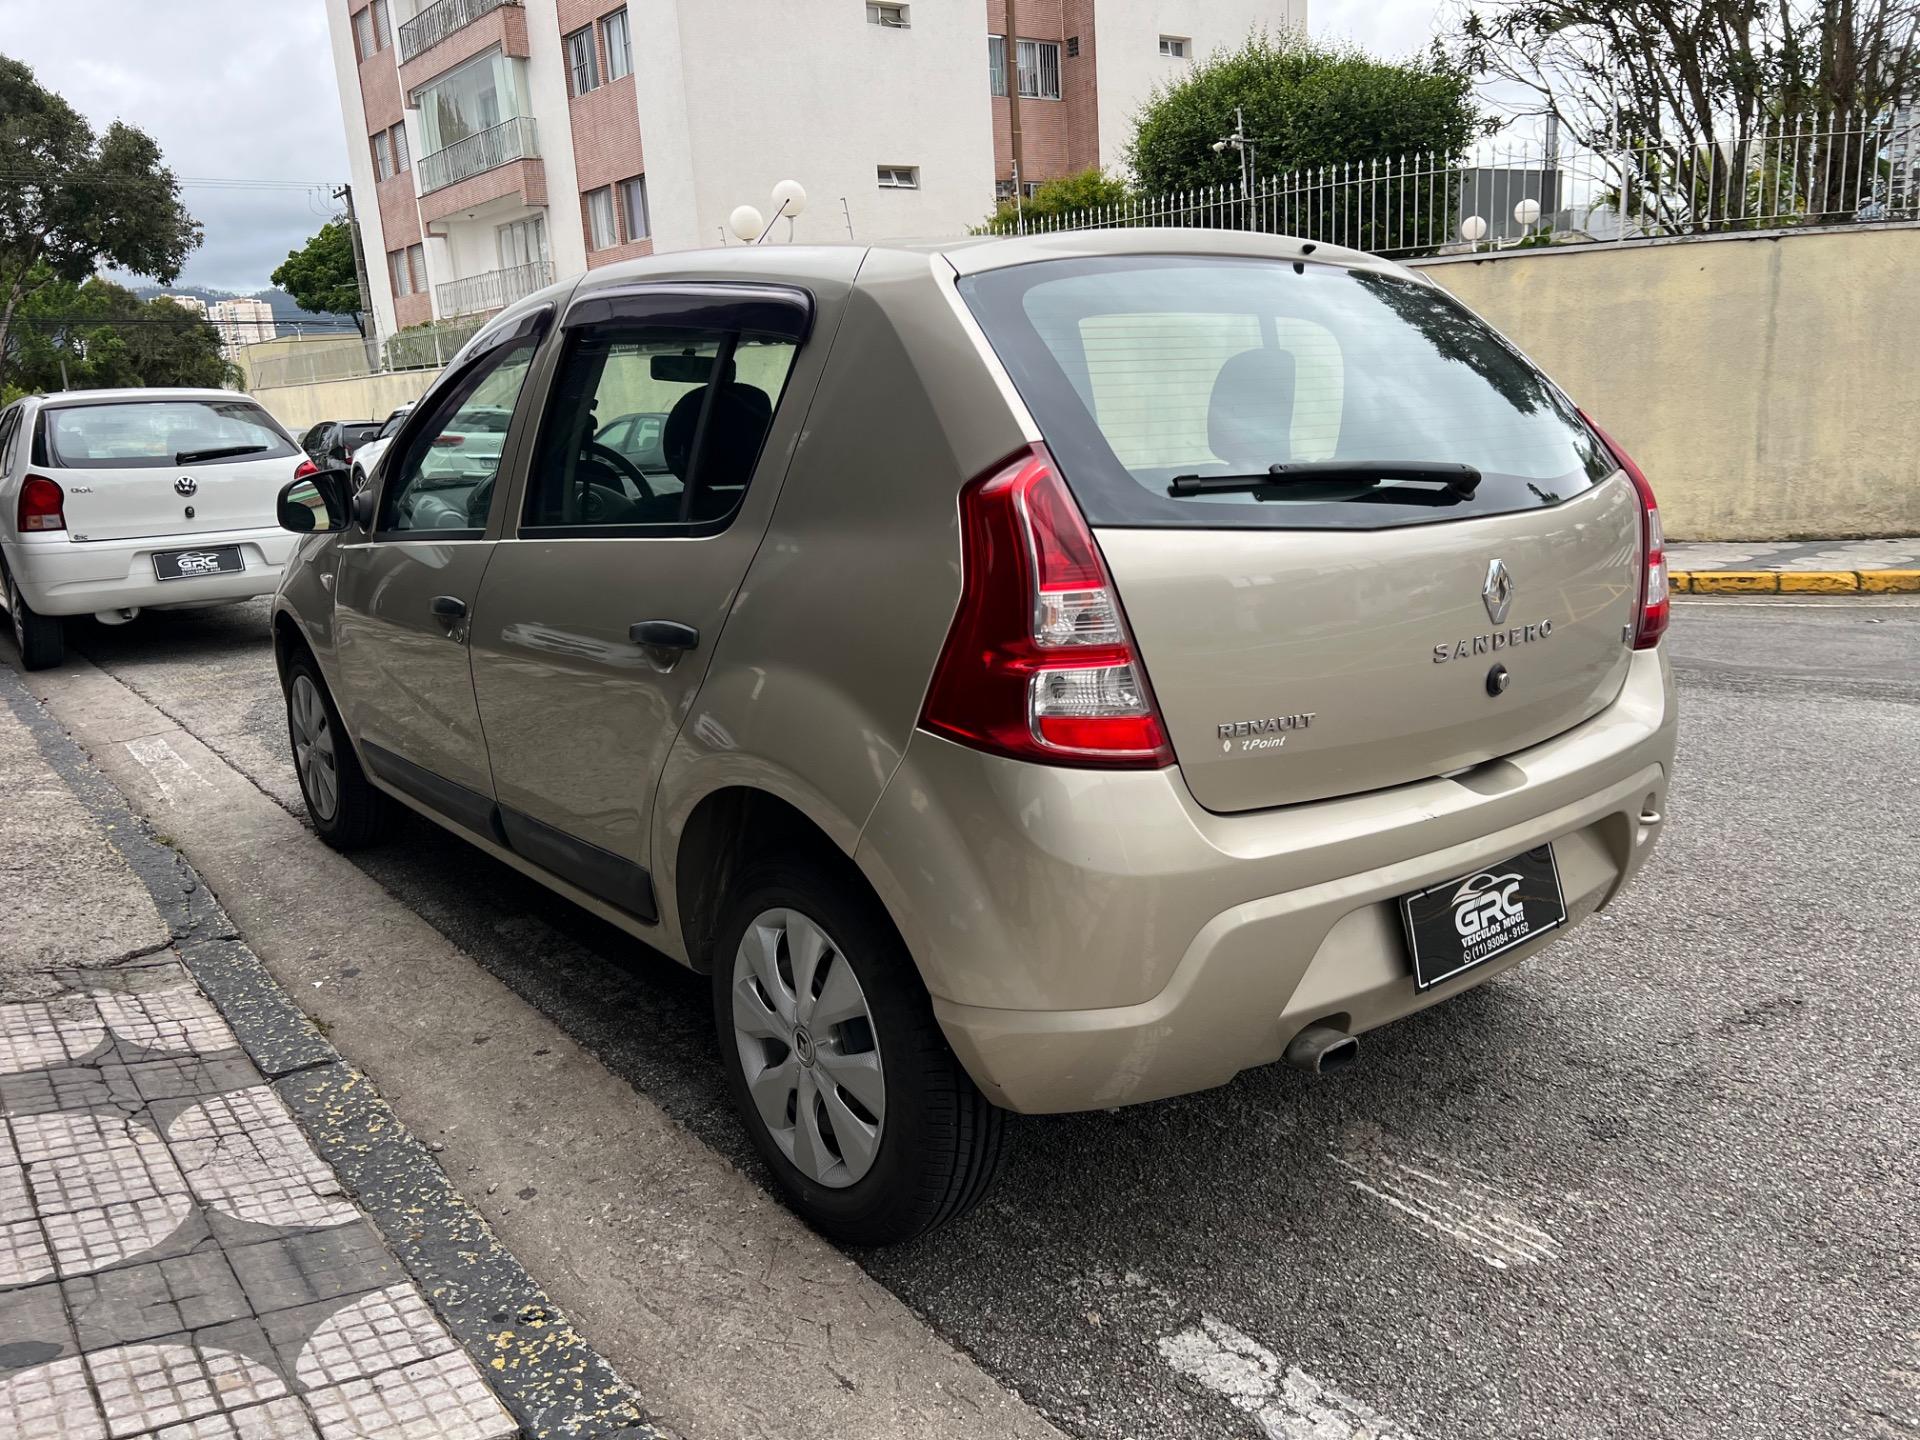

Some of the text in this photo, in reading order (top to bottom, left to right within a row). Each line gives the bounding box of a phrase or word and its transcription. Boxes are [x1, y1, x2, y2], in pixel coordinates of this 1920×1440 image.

[177, 556, 218, 569] GRC
[1433, 619, 1553, 664] SANDERO
[1217, 712, 1316, 739] RENAULT
[1455, 881, 1524, 936] GRC
[1461, 911, 1525, 948] VEICULOS MOGI
[1472, 942, 1487, 960] (11)
[1512, 921, 1530, 938] 9152
